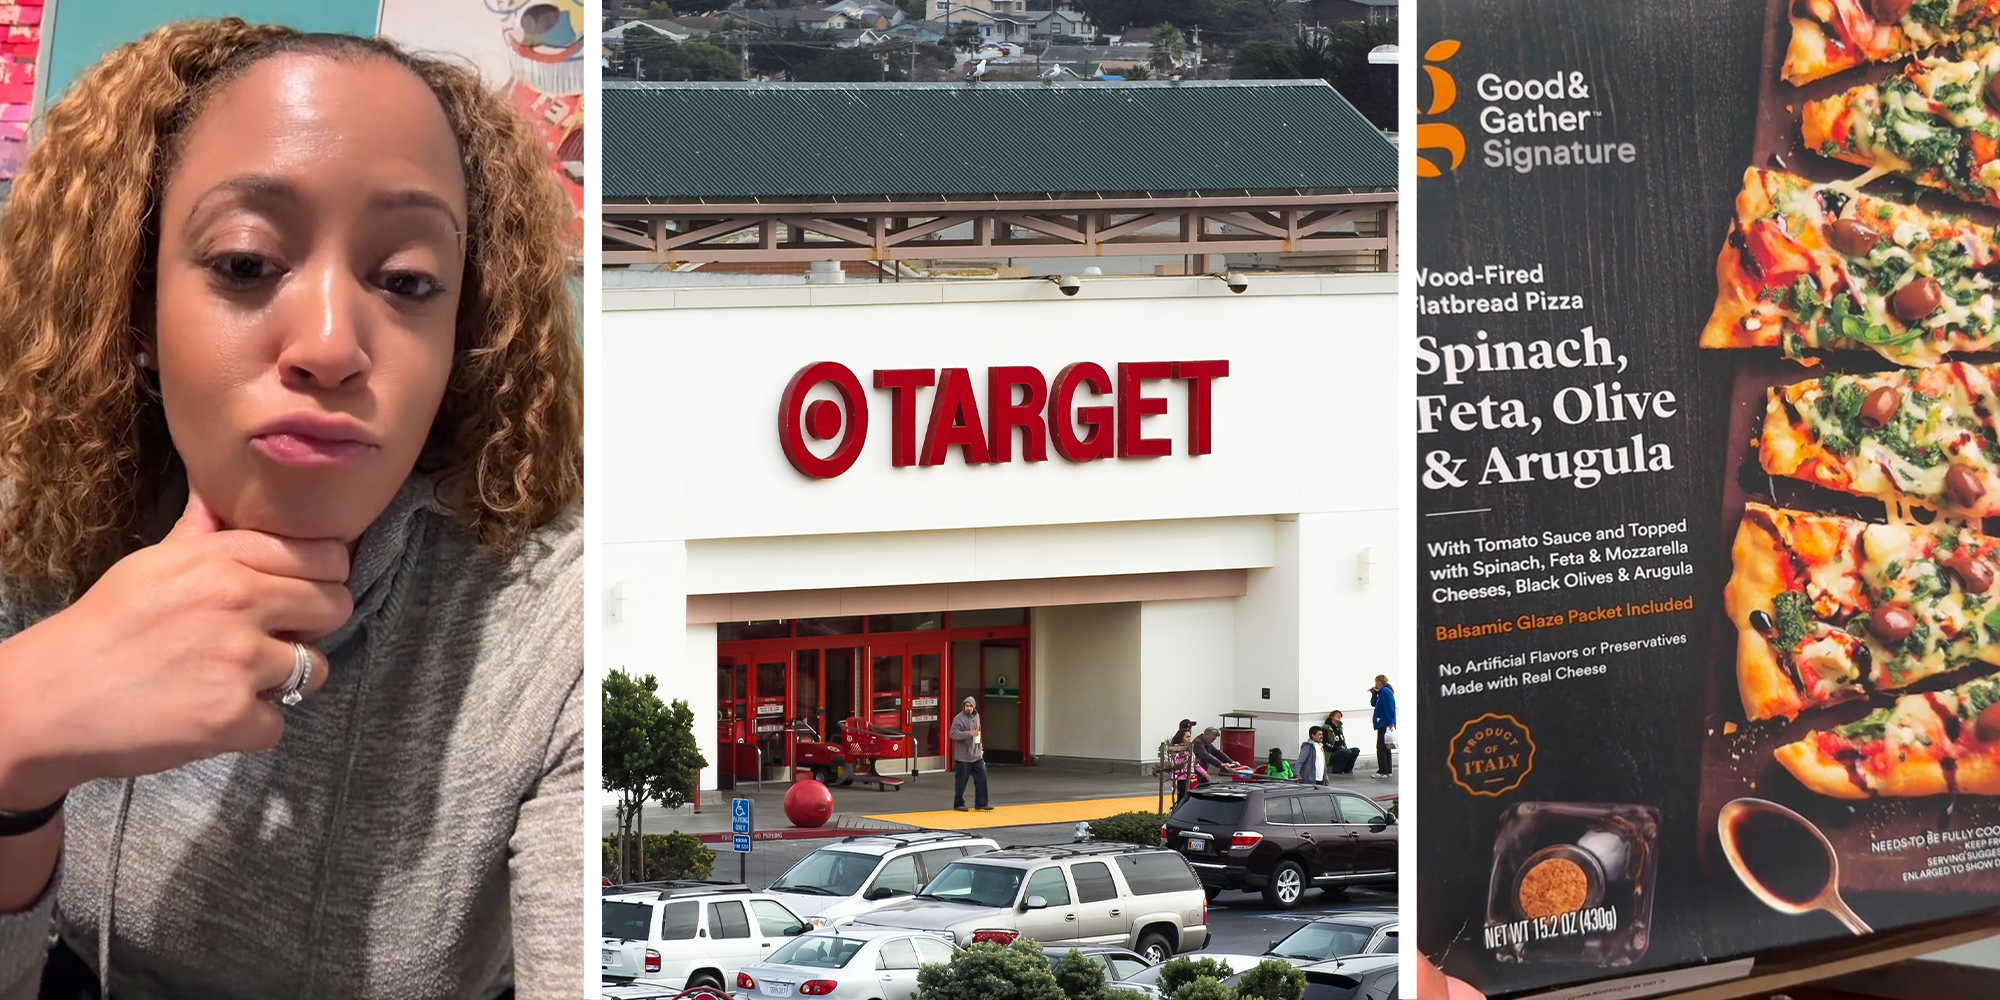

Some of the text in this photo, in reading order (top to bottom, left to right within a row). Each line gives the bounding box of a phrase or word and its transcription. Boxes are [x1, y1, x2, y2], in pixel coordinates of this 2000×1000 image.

[1484, 138, 1636, 173] Signature
[1417, 291, 1584, 315] latbread Pizza
[1417, 326, 1628, 385] Spinach,
[873, 359, 1229, 467] TARGET
[1417, 381, 1677, 436] Feta, Olive
[1422, 433, 1675, 490] & Arugula
[1428, 518, 1687, 557] With Tomato Sauce and Topped
[1431, 540, 1688, 581] with Spinach, Feta & Mozzarella
[1432, 561, 1693, 604] Cheeses, Black Olives & Arugula
[1436, 595, 1694, 641] Balsamic Glaze Packet Included
[1439, 633, 1687, 678] No Artificial Flavors or Preservatives
[1441, 663, 1607, 697] Made with Real Cheese
[1463, 728, 1518, 753] PRODUCT
[1485, 745, 1498, 754] OF
[1464, 753, 1520, 775] ITALY
[1871, 838, 1908, 853] NEEDS
[1909, 835, 1925, 846] TO
[1927, 833, 1939, 844] BE
[1942, 828, 1973, 842] FULLY
[1927, 852, 1965, 866] SERVING
[1964, 839, 1986, 850] KEEP
[1902, 867, 1950, 882] ENLARGED
[1953, 864, 1964, 873] TO
[1966, 860, 1993, 872] SHOW
[1484, 905, 1617, 949] NET WT 15.2 OZ (430g)
